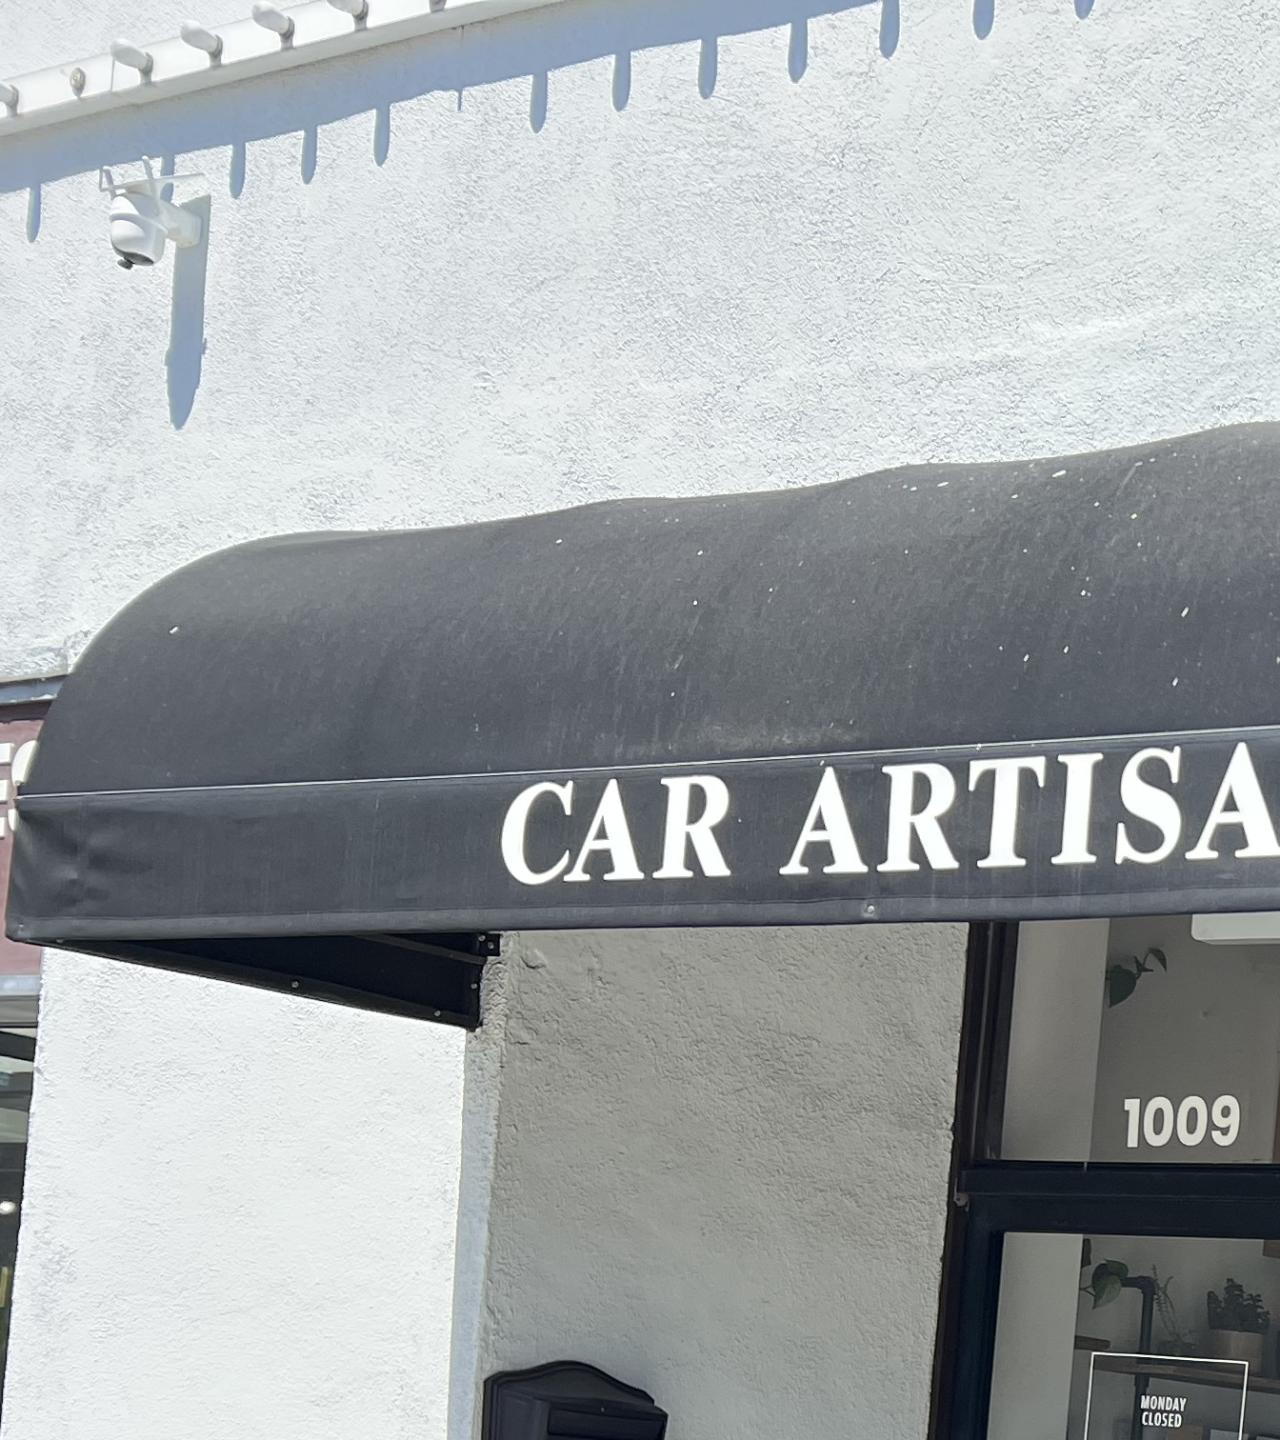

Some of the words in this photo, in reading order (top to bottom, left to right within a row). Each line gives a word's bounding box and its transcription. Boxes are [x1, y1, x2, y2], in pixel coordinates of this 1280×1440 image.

[500, 773, 732, 886] CAR
[1123, 1093, 1241, 1149] 1009
[1140, 1395, 1187, 1412] MONDAY
[1142, 1411, 1182, 1428] CLOSED
